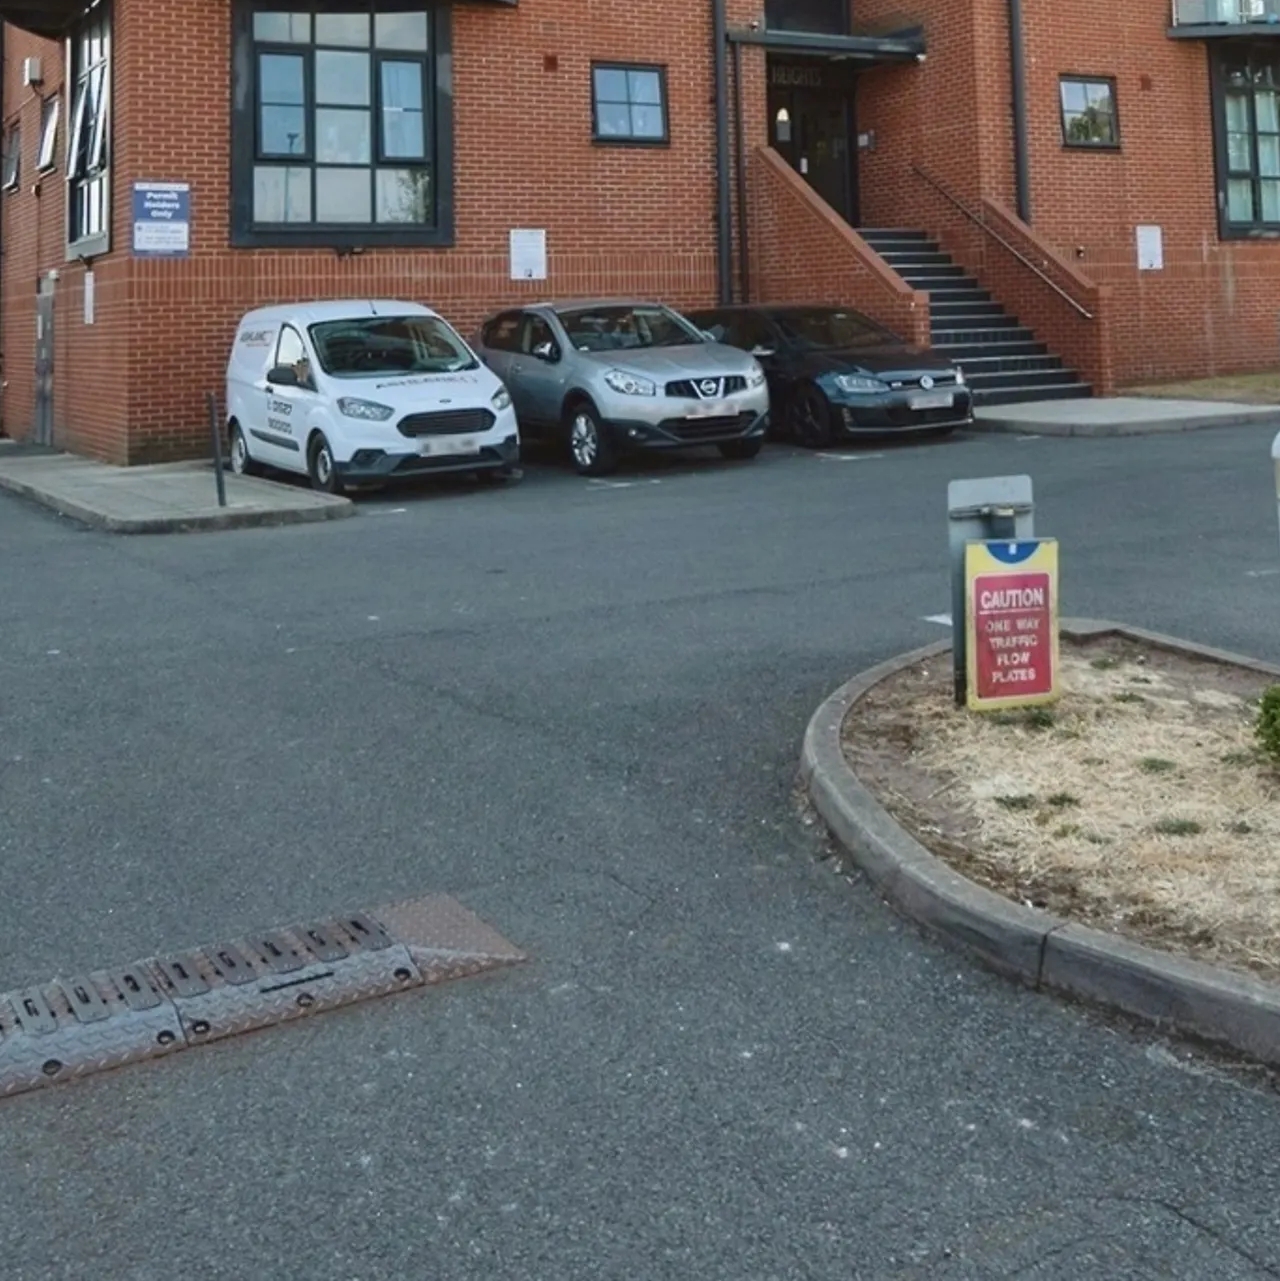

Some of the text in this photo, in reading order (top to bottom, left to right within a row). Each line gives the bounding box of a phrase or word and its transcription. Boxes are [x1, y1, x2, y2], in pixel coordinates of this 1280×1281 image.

[980, 587, 1044, 609] CAUTION
[985, 618, 1040, 633] ONE WAY
[988, 634, 1038, 649] TRAFFIC
[997, 652, 1031, 666] FLOW
[992, 668, 1036, 683] PLATES
